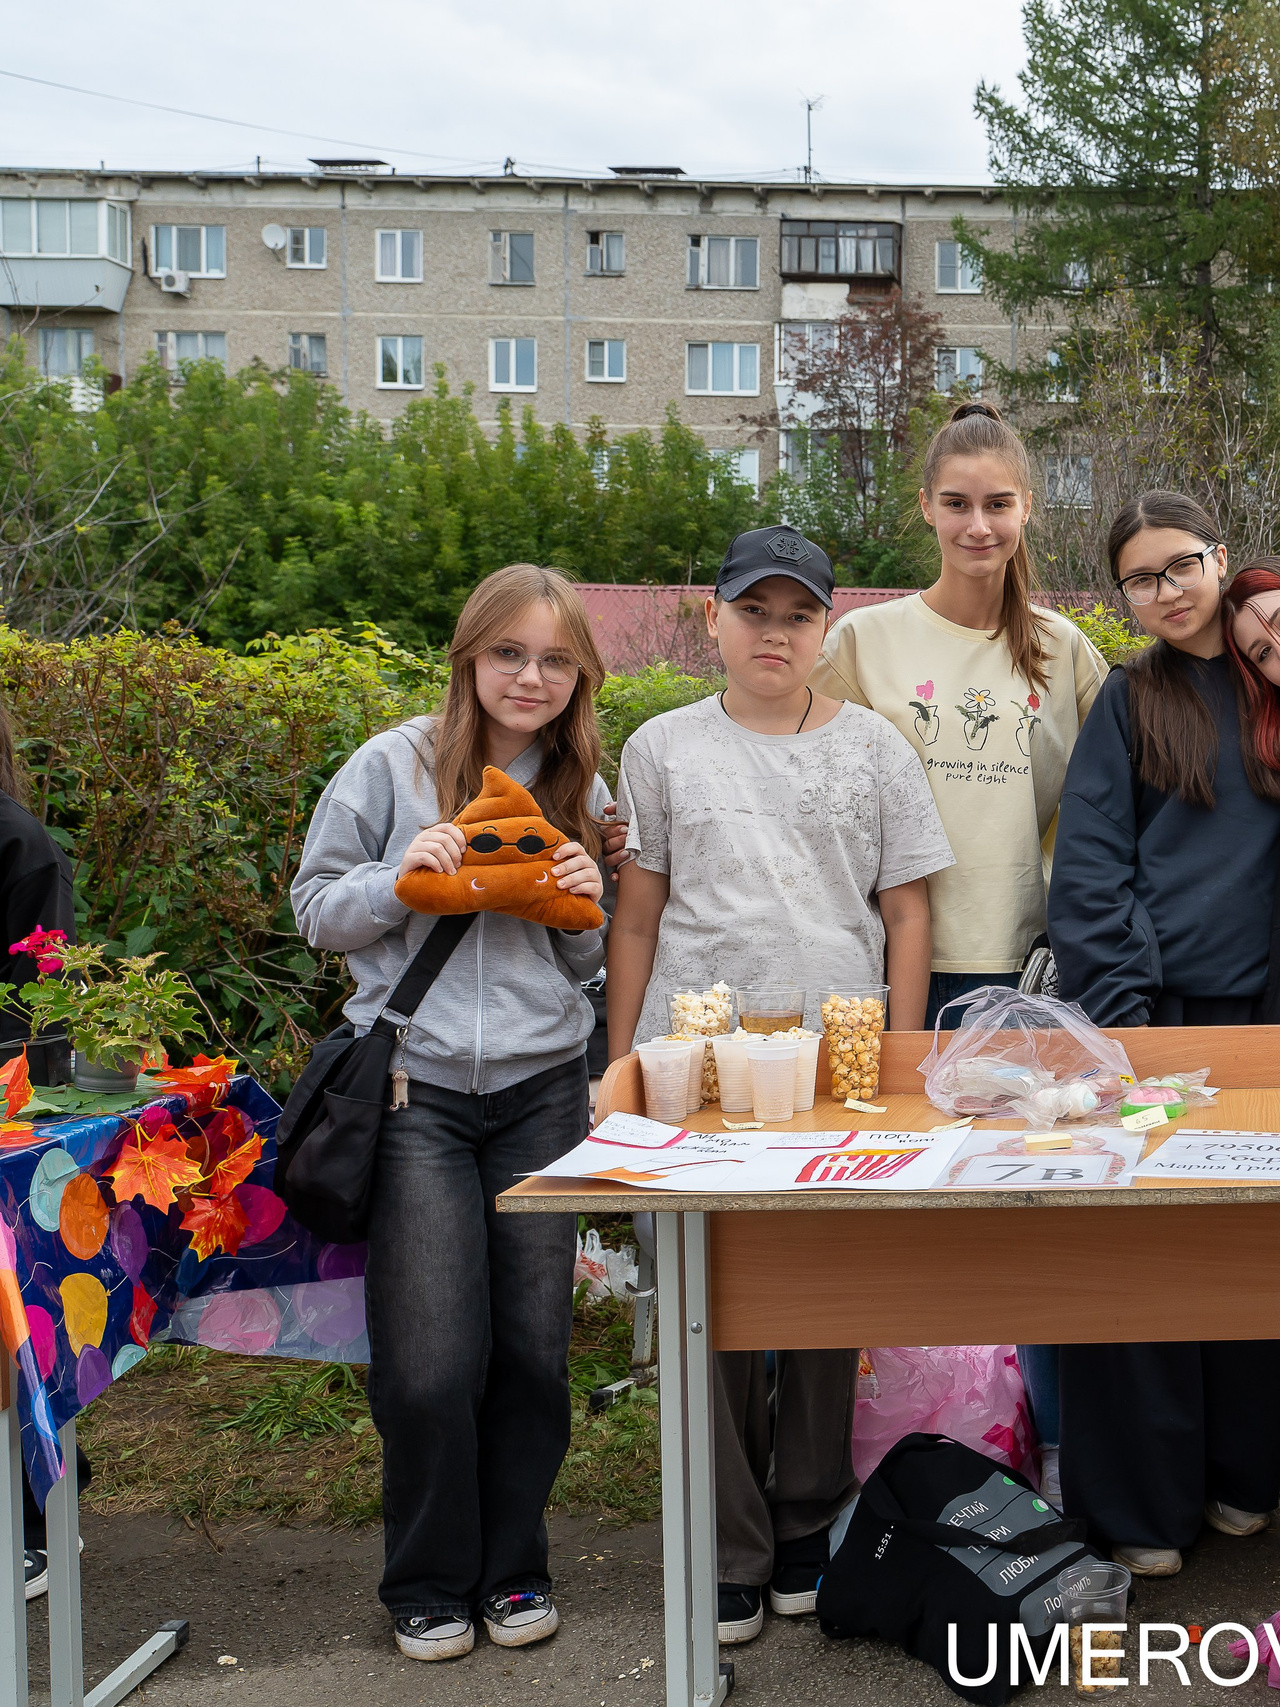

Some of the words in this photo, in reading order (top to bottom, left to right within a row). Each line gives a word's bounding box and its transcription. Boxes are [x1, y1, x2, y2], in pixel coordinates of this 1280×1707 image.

[926, 758, 973, 773] growing
[976, 761, 987, 772] in
[990, 760, 1029, 775] silence
[945, 772, 973, 781] pure
[986, 1164, 1035, 1181] 7
[1154, 1162, 1227, 1171] Мария
[947, 1501, 989, 1527] ЕЧТАЙ
[875, 1532, 892, 1560] 15:51
[999, 1554, 1039, 1585] ЛЮБИ
